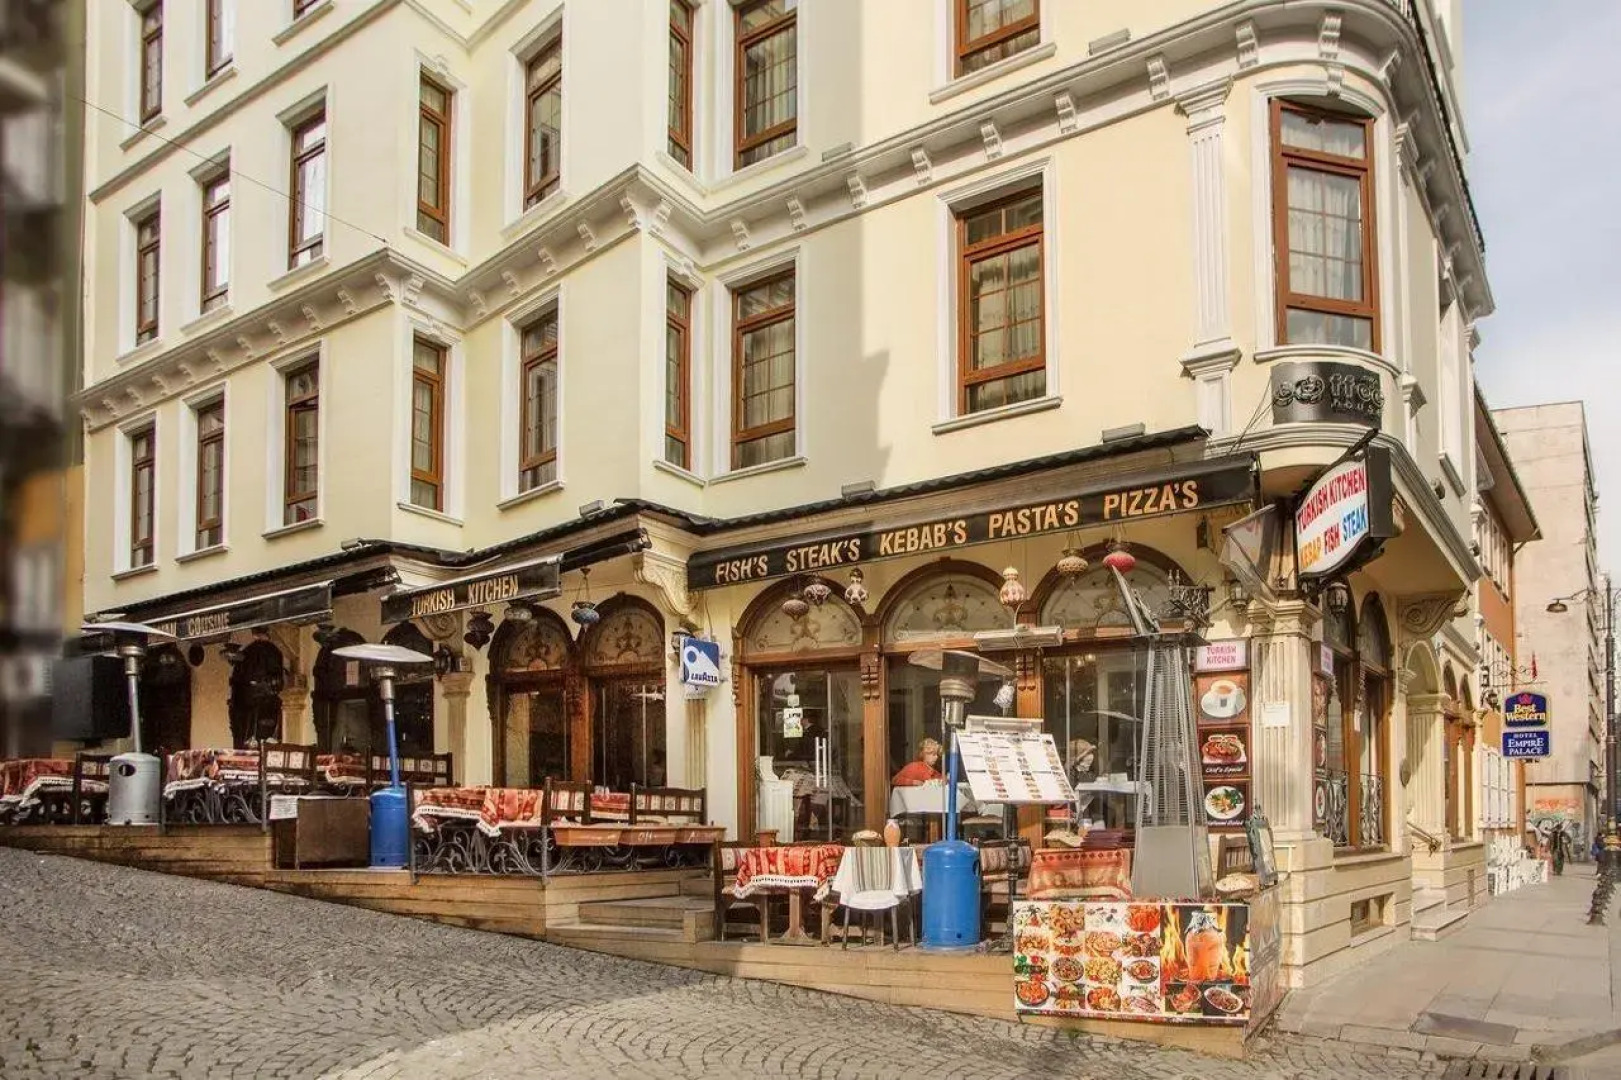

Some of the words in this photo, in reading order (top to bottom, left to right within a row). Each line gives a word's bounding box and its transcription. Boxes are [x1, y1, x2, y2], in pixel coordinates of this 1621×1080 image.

[1298, 485, 1328, 534] TURKISH
[1329, 467, 1365, 507] KITCHEN
[714, 554, 768, 584] FISH'S
[786, 538, 861, 572] STEAK'S
[879, 520, 968, 556] KEBAB'S
[988, 500, 1079, 539] PASTA'S
[1103, 480, 1199, 520] PIZZA'S
[1324, 522, 1340, 555] FISH
[1343, 504, 1366, 542] STEAK
[411, 588, 455, 617] TURKISH
[467, 574, 519, 605] KITCHEN
[1206, 645, 1237, 654] TURKISH
[1206, 655, 1237, 664] KITCHEN
[1514, 704, 1536, 713] Best
[1506, 712, 1546, 721] Western
[1507, 738, 1544, 748] EMPIRE
[1509, 746, 1543, 755] PALACE
